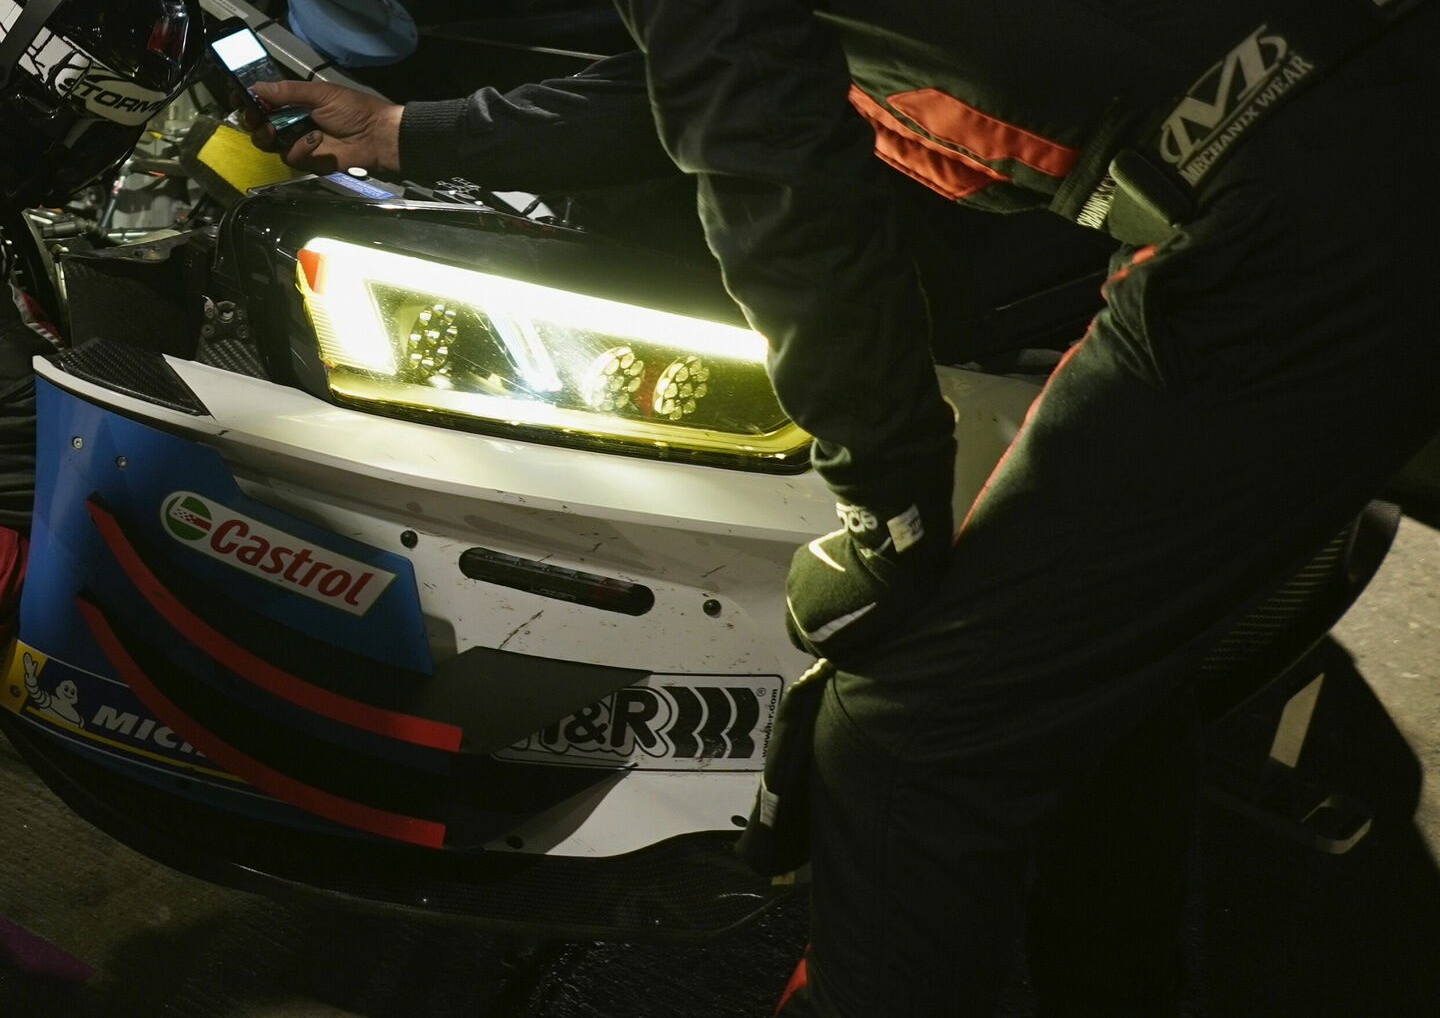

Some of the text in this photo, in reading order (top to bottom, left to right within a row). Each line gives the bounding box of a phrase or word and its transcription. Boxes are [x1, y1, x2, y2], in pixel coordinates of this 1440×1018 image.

[1178, 54, 1316, 188] MECHANIX WEAR
[211, 519, 375, 607] Castrol
[91, 704, 202, 756] MIC
